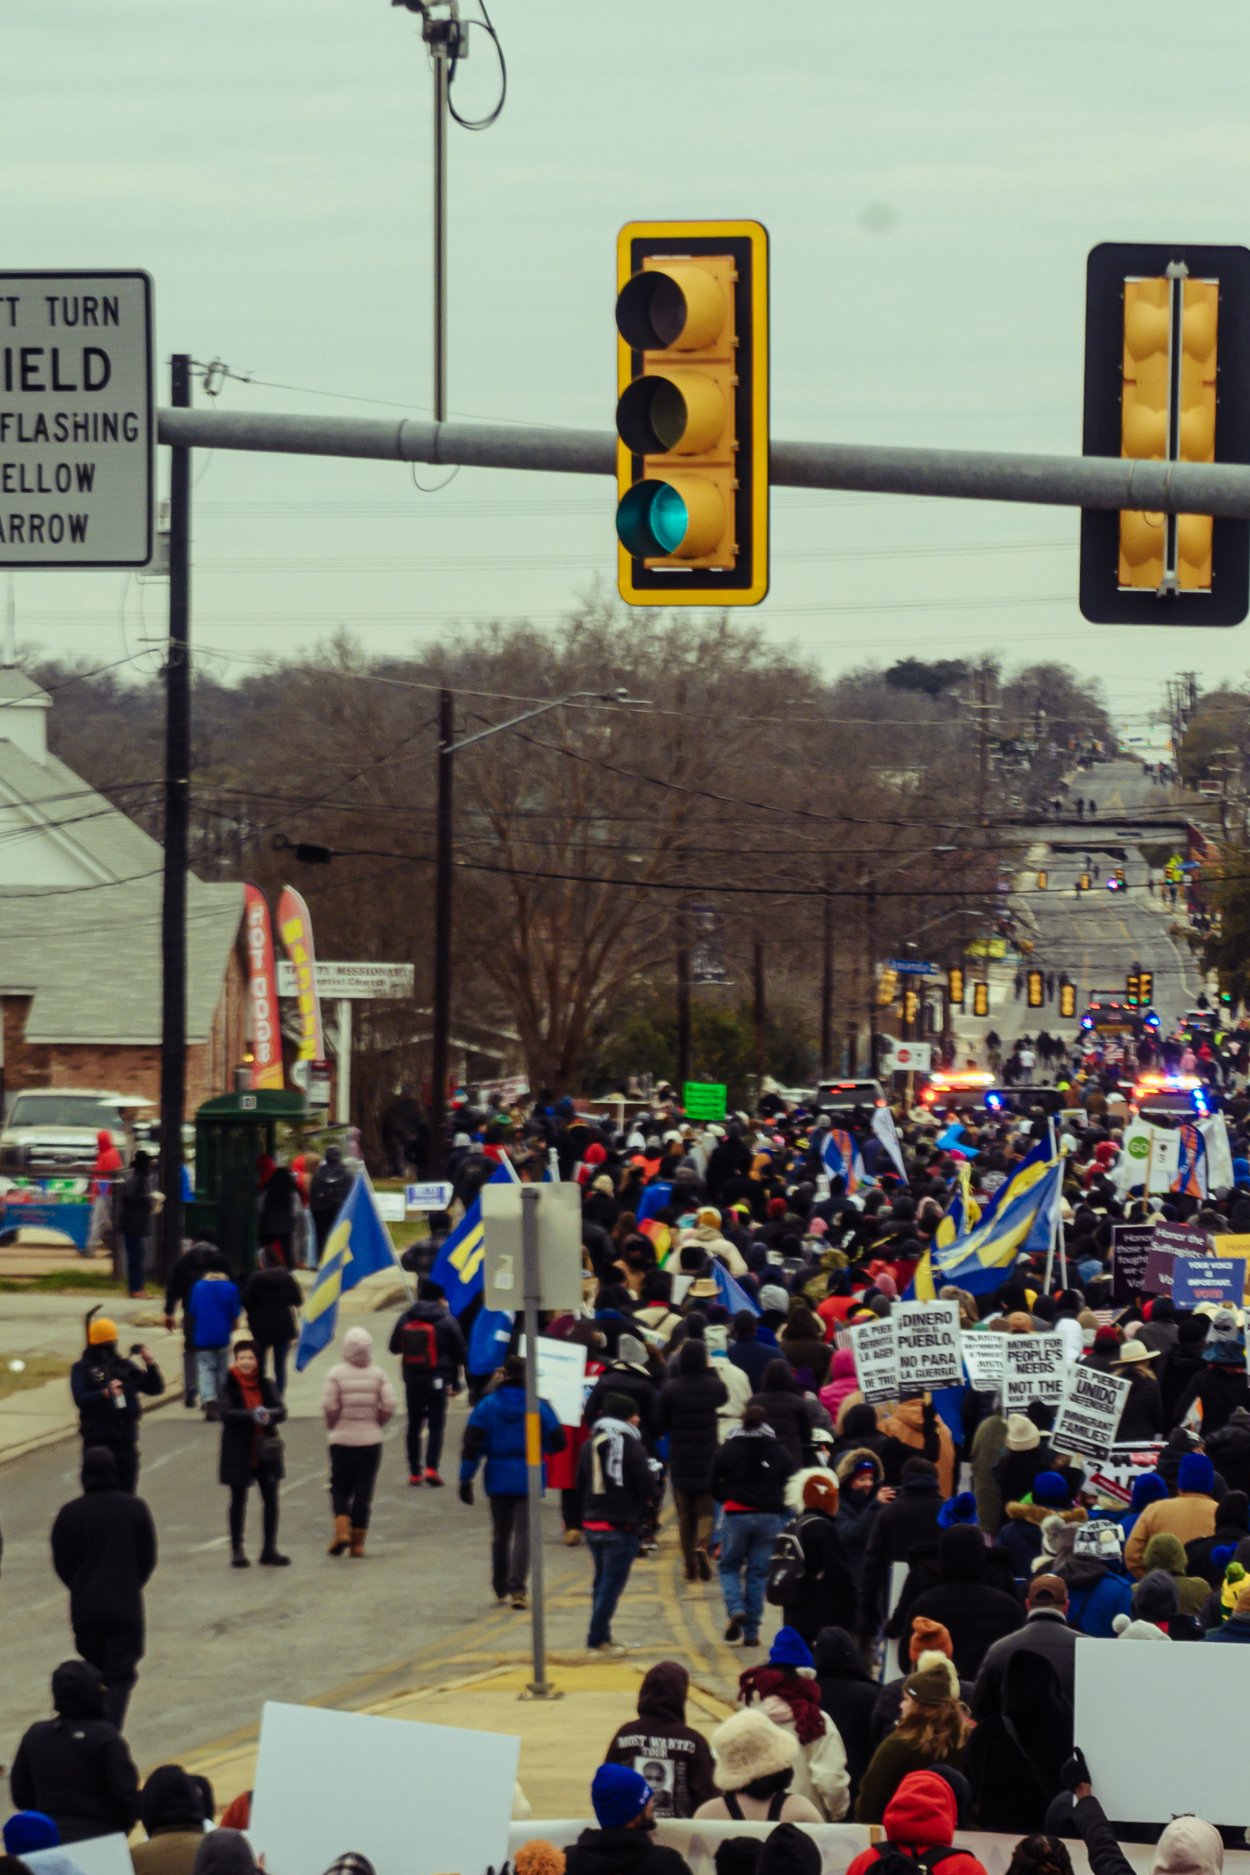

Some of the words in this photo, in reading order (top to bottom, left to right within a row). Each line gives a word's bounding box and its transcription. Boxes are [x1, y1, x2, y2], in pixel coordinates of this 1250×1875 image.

[45, 296, 120, 327] TURN
[4, 347, 112, 392] IELD
[0, 411, 139, 443] FLASHING
[2, 462, 97, 493] ELLOW
[248, 904, 265, 970] HOT
[337, 967, 408, 977] MISSIONARY
[252, 975, 272, 1064] DOGS
[1155, 1227, 1186, 1241] Honor
[1187, 1234, 1205, 1246] the
[897, 1332, 956, 1349] PUEBLO,
[1007, 1340, 1040, 1350] MONEY
[1044, 1338, 1063, 1348] FOR
[900, 1355, 917, 1368] NO
[921, 1352, 957, 1367] PARA
[1007, 1349, 1063, 1362] PEOPLE'S
[900, 1370, 912, 1380] LA
[1016, 1361, 1055, 1374] NEEDS
[1008, 1380, 1034, 1394] NOT
[1038, 1380, 1063, 1393] THE
[1076, 1380, 1117, 1405] UNIDO
[618, 1734, 646, 1749] MOST
